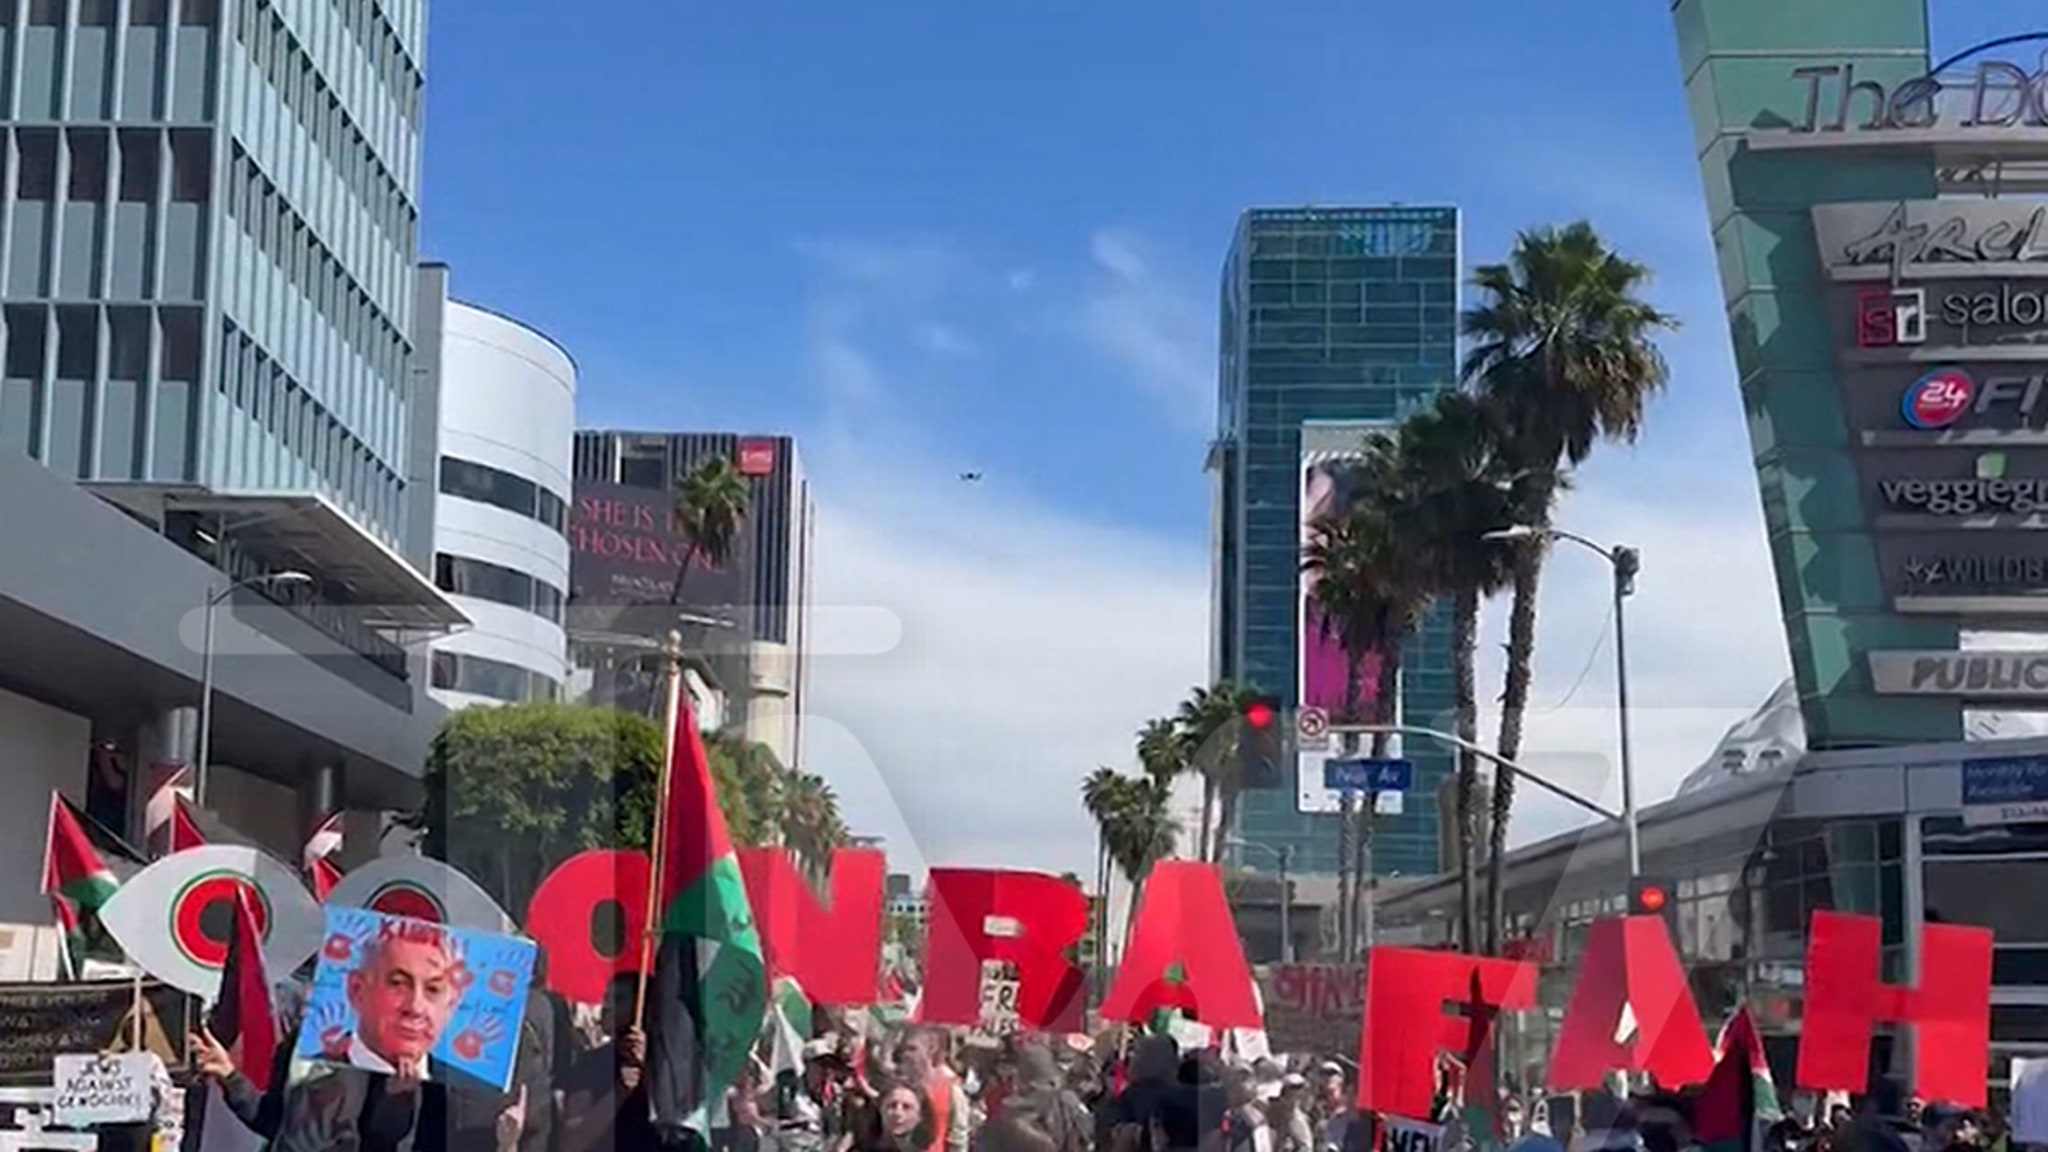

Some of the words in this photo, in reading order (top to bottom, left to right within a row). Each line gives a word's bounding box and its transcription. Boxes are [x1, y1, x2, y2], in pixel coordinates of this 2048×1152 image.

[1789, 63, 1940, 132] The
[1944, 284, 2048, 325] salo
[1919, 380, 1968, 410] 24
[1975, 375, 2048, 413] FI
[580, 497, 625, 527] SHE
[633, 504, 656, 533] IS
[570, 521, 668, 565] HOSEN
[1377, 766, 1401, 782] Av
[64, 1078, 133, 1093] AGAINST
